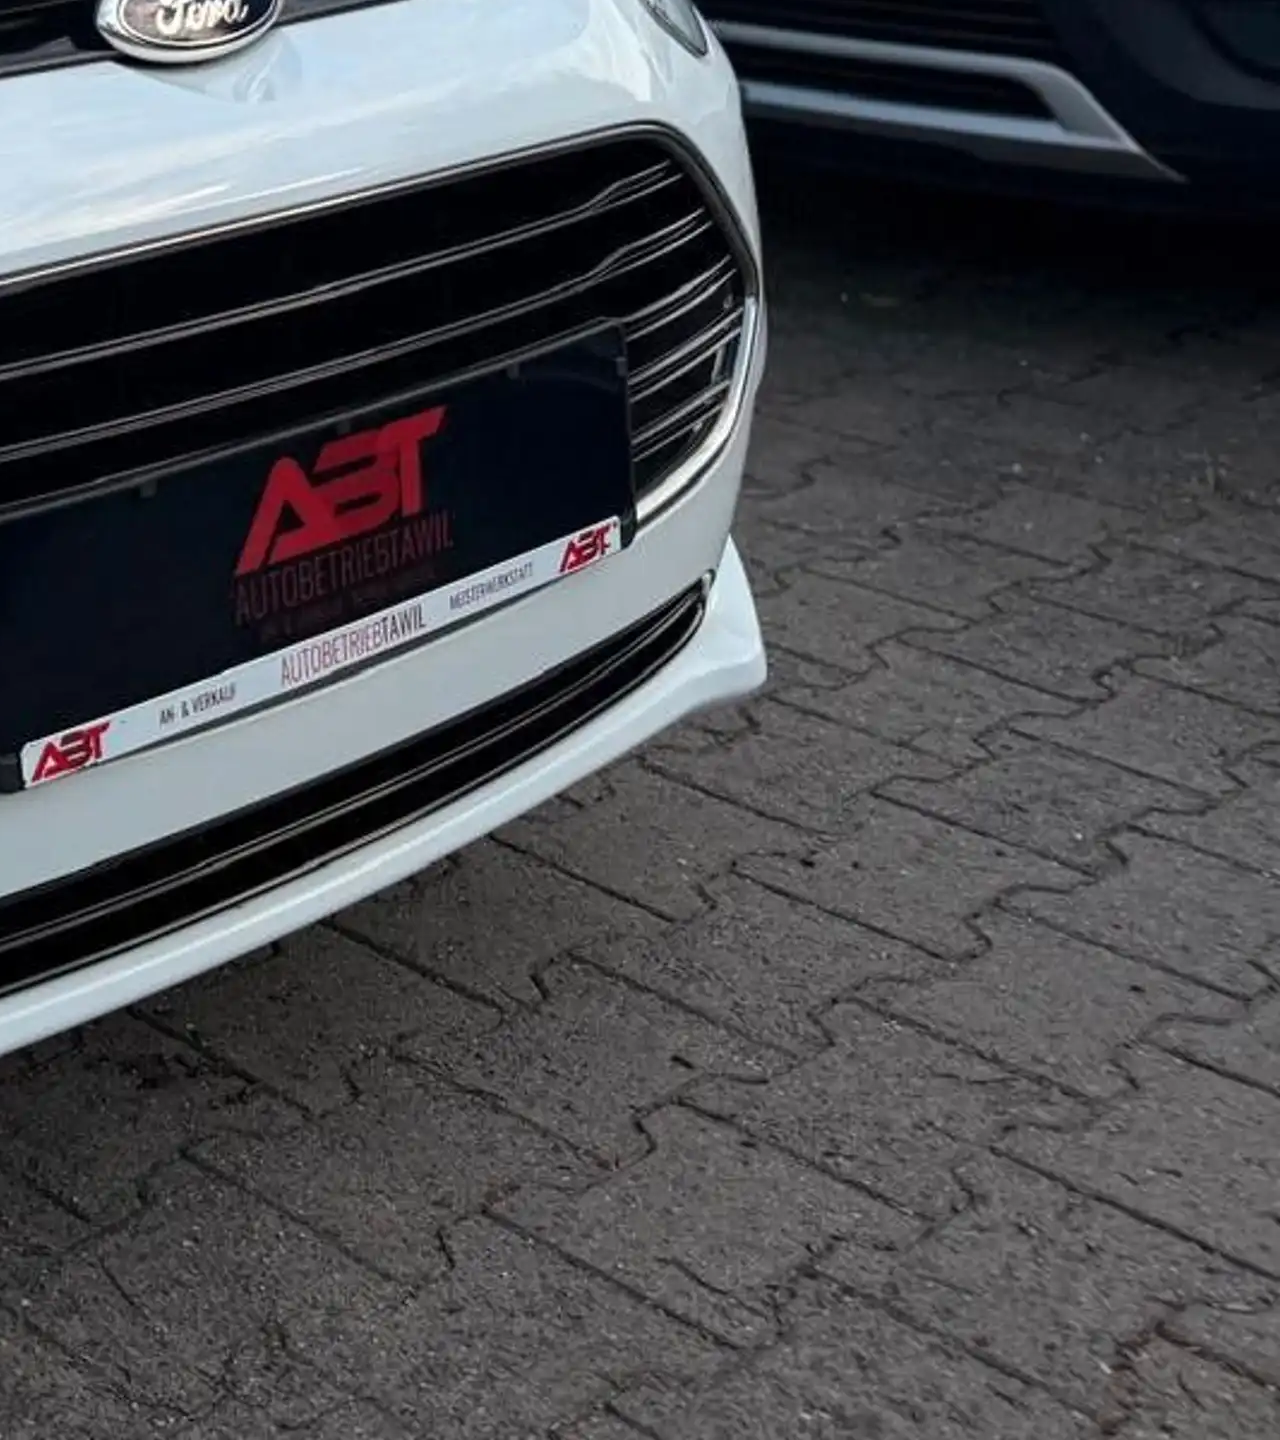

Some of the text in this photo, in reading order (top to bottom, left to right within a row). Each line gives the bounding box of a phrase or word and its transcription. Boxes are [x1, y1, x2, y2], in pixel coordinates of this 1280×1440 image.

[235, 406, 446, 574] ABT
[281, 604, 426, 687] AUTOBETRIEBTAWIL
[32, 722, 111, 781] ABT
